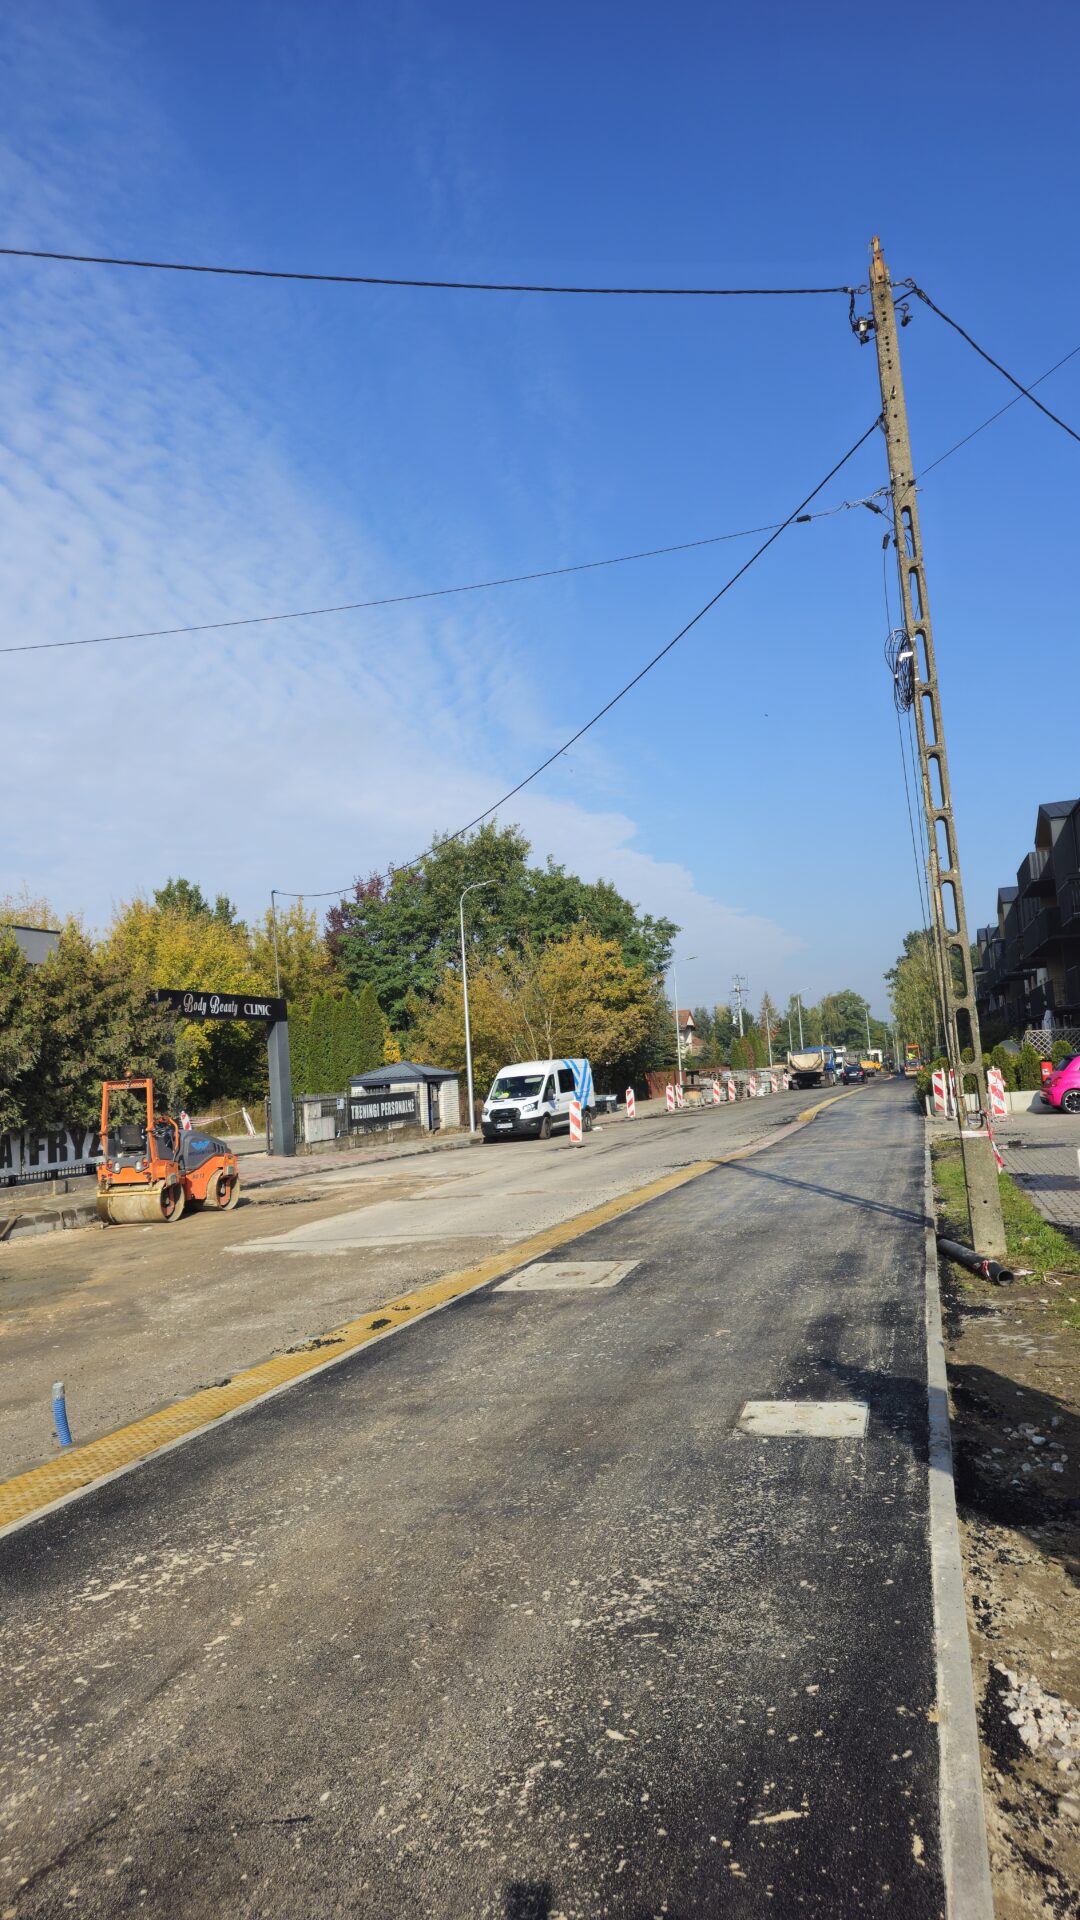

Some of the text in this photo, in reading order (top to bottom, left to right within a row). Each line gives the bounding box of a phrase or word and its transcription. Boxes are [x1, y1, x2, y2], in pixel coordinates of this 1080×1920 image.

[183, 993, 272, 1016] Body Beauty CLINIC
[351, 1099, 415, 1120] TRENINGI PERSONALNE
